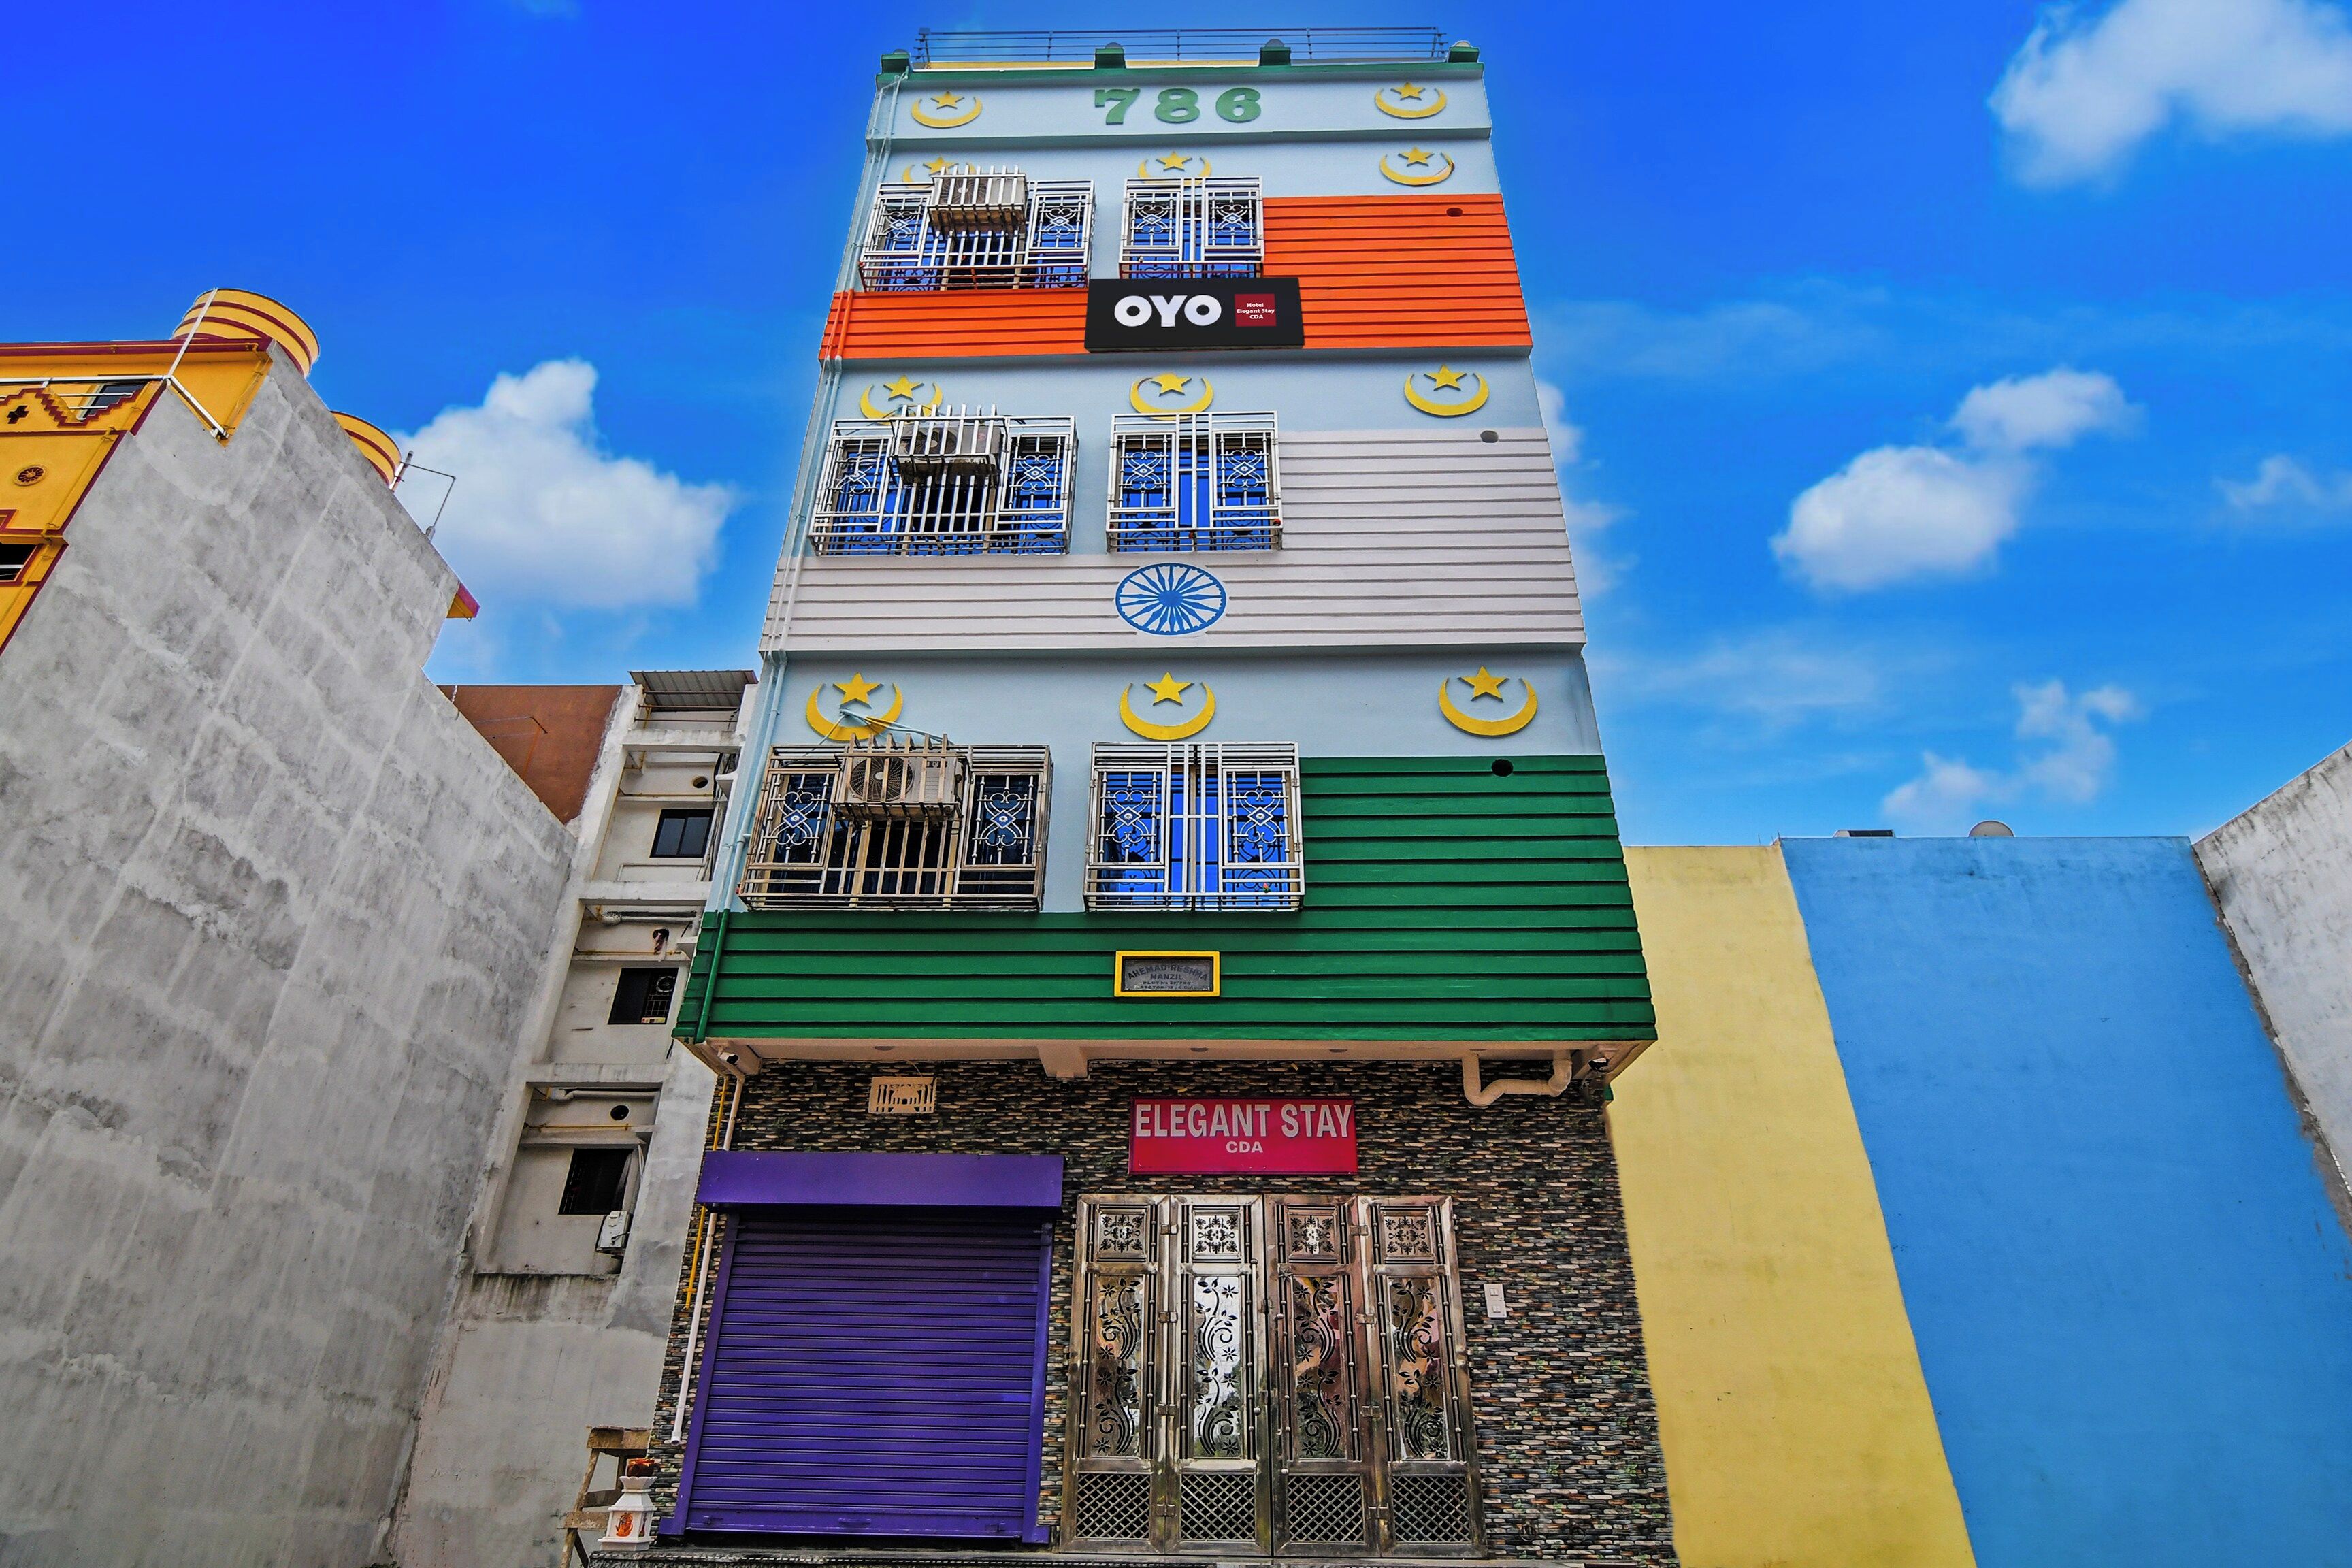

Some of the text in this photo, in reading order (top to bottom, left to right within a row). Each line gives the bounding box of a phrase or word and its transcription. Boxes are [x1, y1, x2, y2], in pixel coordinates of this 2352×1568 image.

[1094, 88, 1261, 125] 786
[1114, 294, 1222, 327] OYO
[1135, 1103, 1352, 1138] ELEGANT STAY
[1226, 1141, 1264, 1154] CDA
